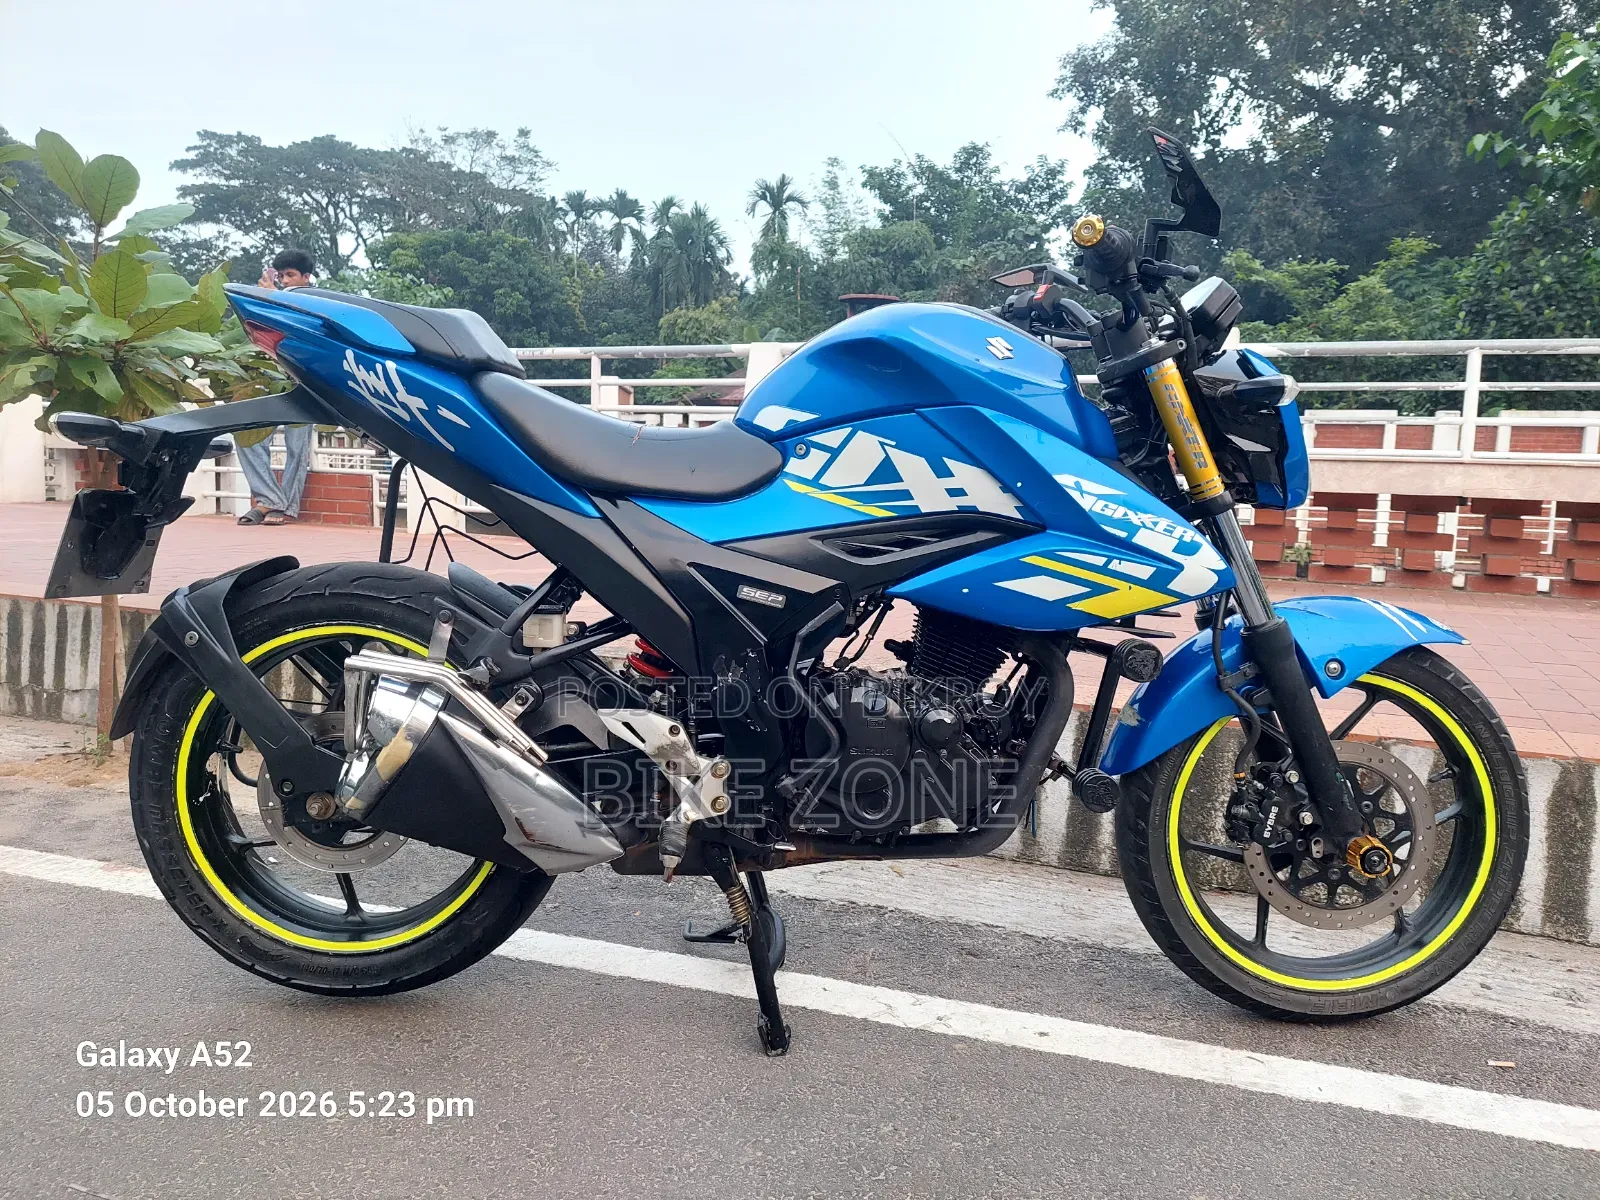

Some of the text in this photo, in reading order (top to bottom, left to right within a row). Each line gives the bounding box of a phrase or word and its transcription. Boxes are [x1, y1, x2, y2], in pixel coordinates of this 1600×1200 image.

[1090, 498, 1196, 543] GIXXER
[740, 587, 784, 602] SEP
[1263, 805, 1280, 839] BYBRE
